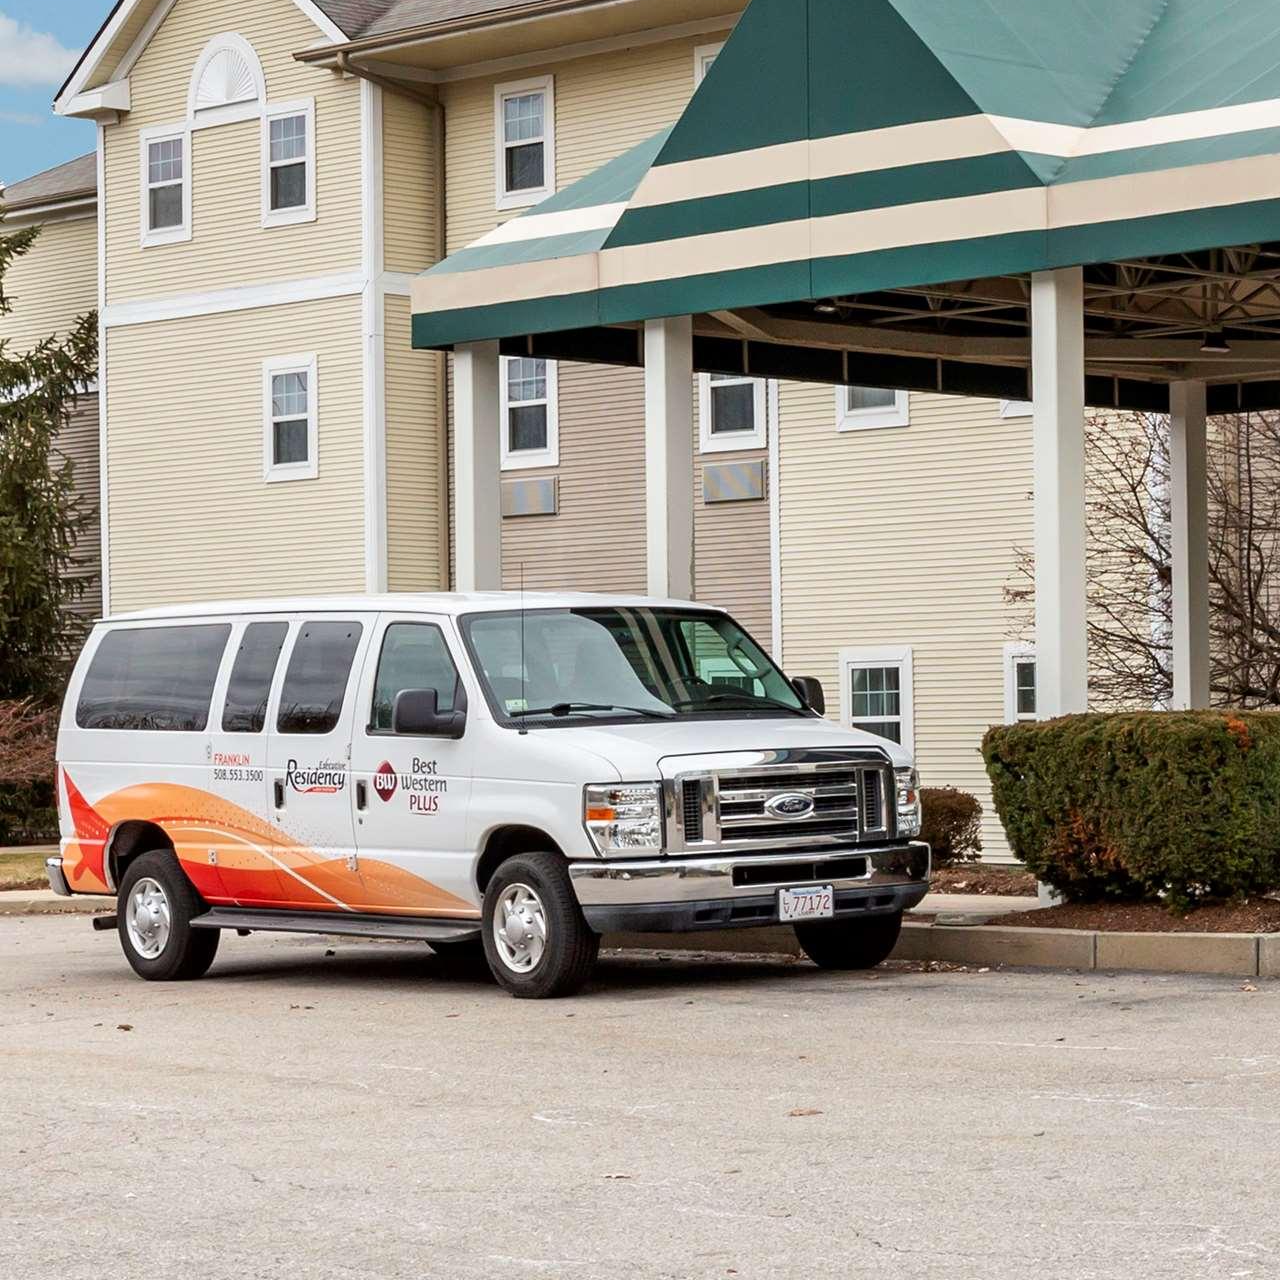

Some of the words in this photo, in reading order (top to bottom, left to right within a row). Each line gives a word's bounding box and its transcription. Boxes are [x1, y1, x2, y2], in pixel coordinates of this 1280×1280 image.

[214, 753, 250, 765] FRANKLIN
[412, 757, 437, 774] Best
[214, 768, 264, 782] 508.553.3500
[286, 759, 346, 791] Residency
[376, 773, 395, 790] BW
[401, 775, 447, 792] Western
[409, 794, 438, 811] PLUS
[793, 894, 830, 912] 77172
